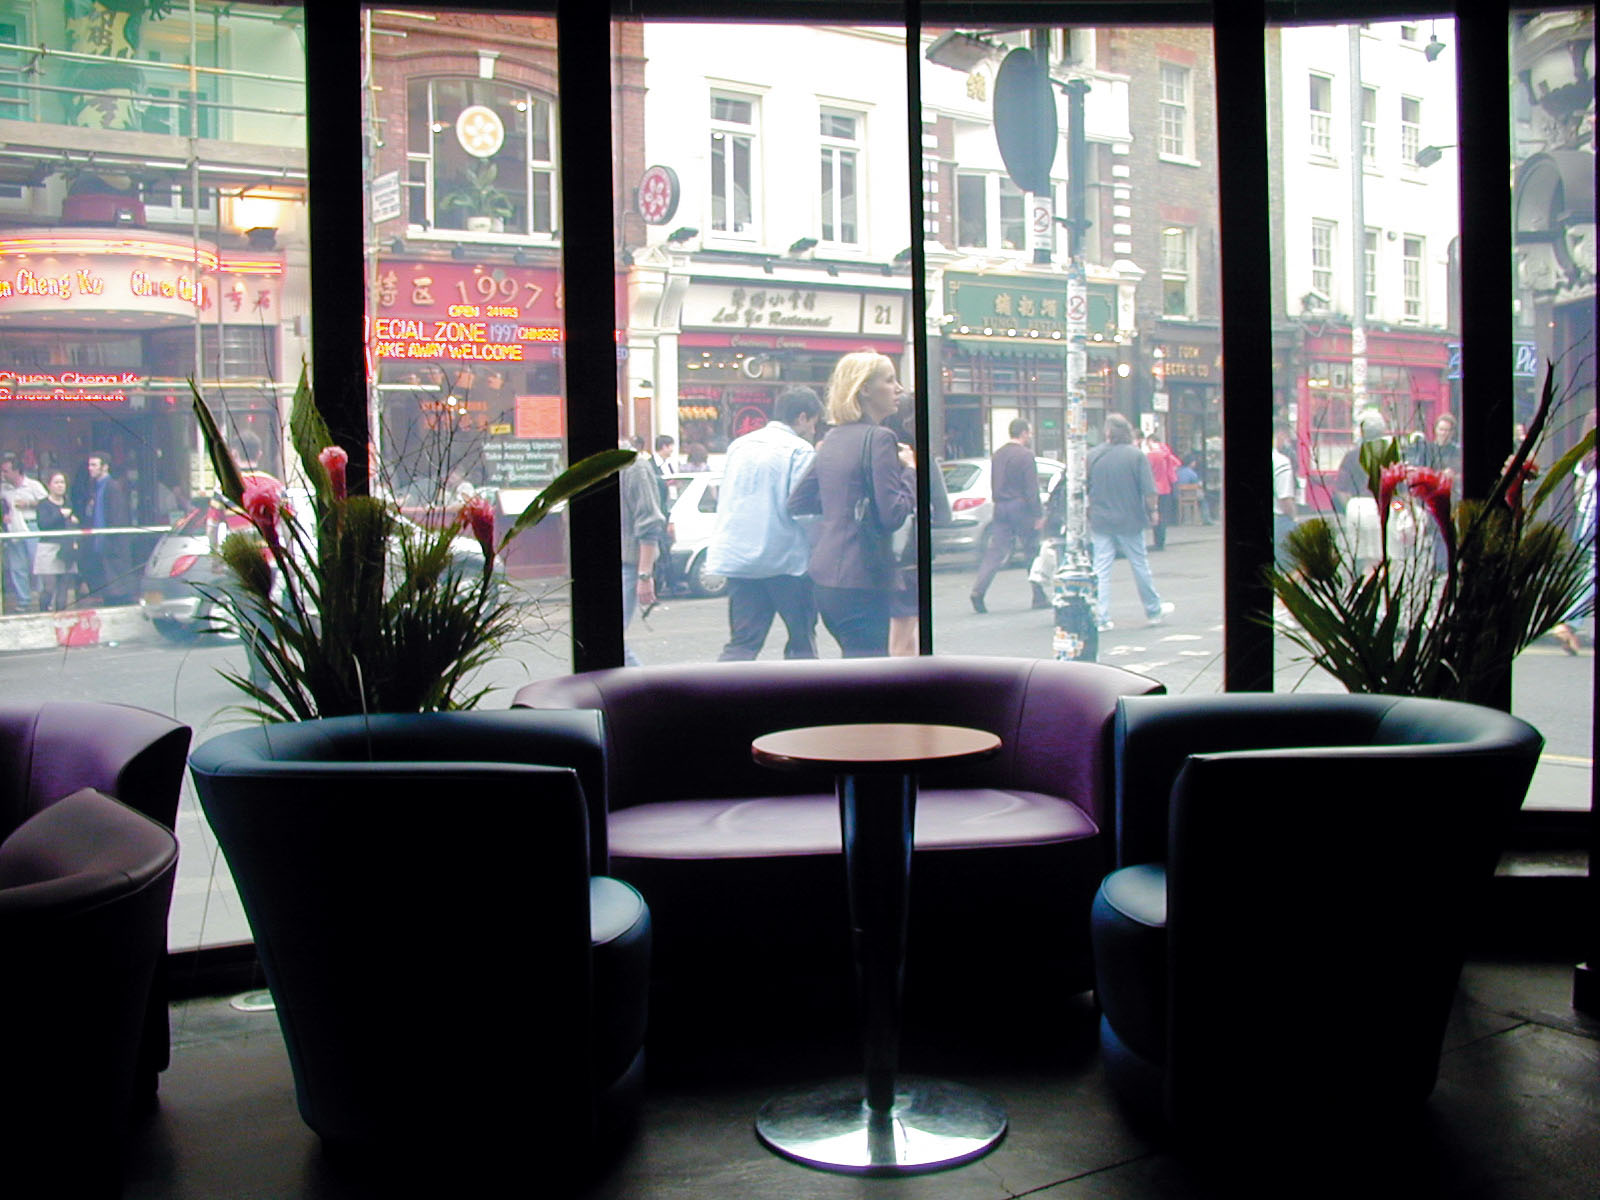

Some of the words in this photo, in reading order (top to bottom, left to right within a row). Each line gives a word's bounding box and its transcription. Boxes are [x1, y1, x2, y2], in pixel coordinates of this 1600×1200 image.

[16, 268, 72, 299] Cheng
[456, 275, 543, 309] 1997
[448, 304, 480, 317] OPEN
[874, 305, 892, 325] 21
[434, 321, 486, 342] ZONE
[490, 322, 518, 342] 1997
[518, 327, 559, 341] CHINESE
[408, 343, 446, 357] AWAY
[448, 343, 522, 360] WELCOME
